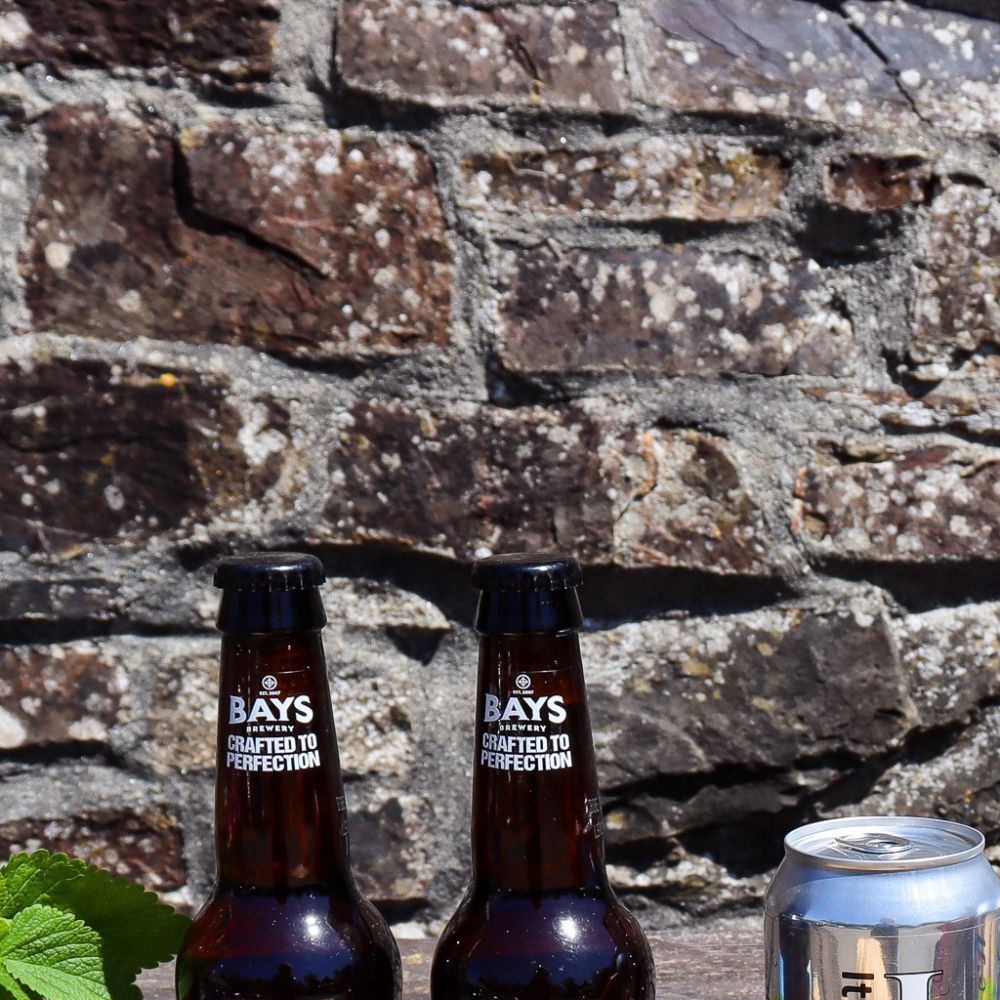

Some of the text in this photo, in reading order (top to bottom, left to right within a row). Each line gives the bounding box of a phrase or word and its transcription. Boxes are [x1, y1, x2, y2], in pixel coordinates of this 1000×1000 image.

[229, 695, 314, 724] BAYS
[483, 693, 567, 723] BAYS
[499, 724, 546, 732] BREWERY
[228, 733, 317, 754] CRAFTED TO
[482, 733, 570, 753] CRAFTED TO
[226, 750, 321, 772] PERFECTION
[480, 749, 573, 771] PERFECTION
